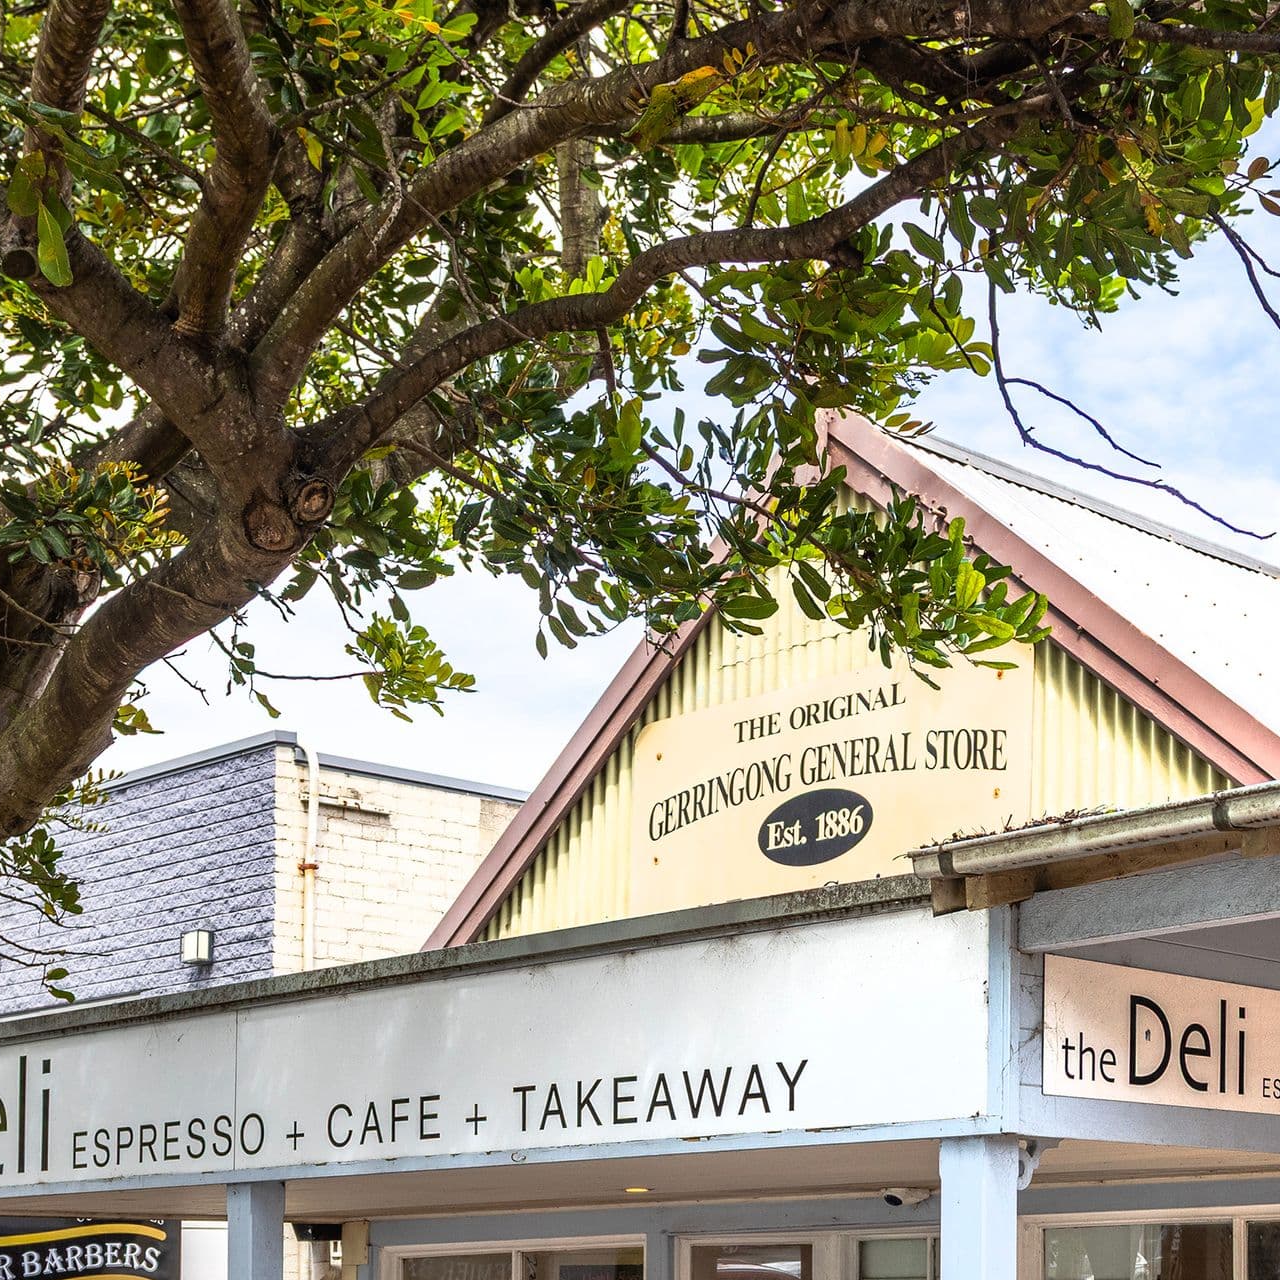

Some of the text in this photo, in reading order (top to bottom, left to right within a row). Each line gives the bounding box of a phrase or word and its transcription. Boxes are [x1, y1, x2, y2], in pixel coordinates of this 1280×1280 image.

[734, 683, 906, 743] THE ORIGINAL
[649, 729, 1008, 842] GERRINGONG GENERAL STORE
[766, 804, 865, 852] Est. 1886
[1061, 1031, 1117, 1084] the
[1128, 994, 1247, 1096] Deli
[72, 1111, 266, 1171] ESPRESSO
[327, 1093, 442, 1149] CAFE
[511, 1058, 810, 1133] TAKEAWAY
[21, 1242, 162, 1279] BARBERS
